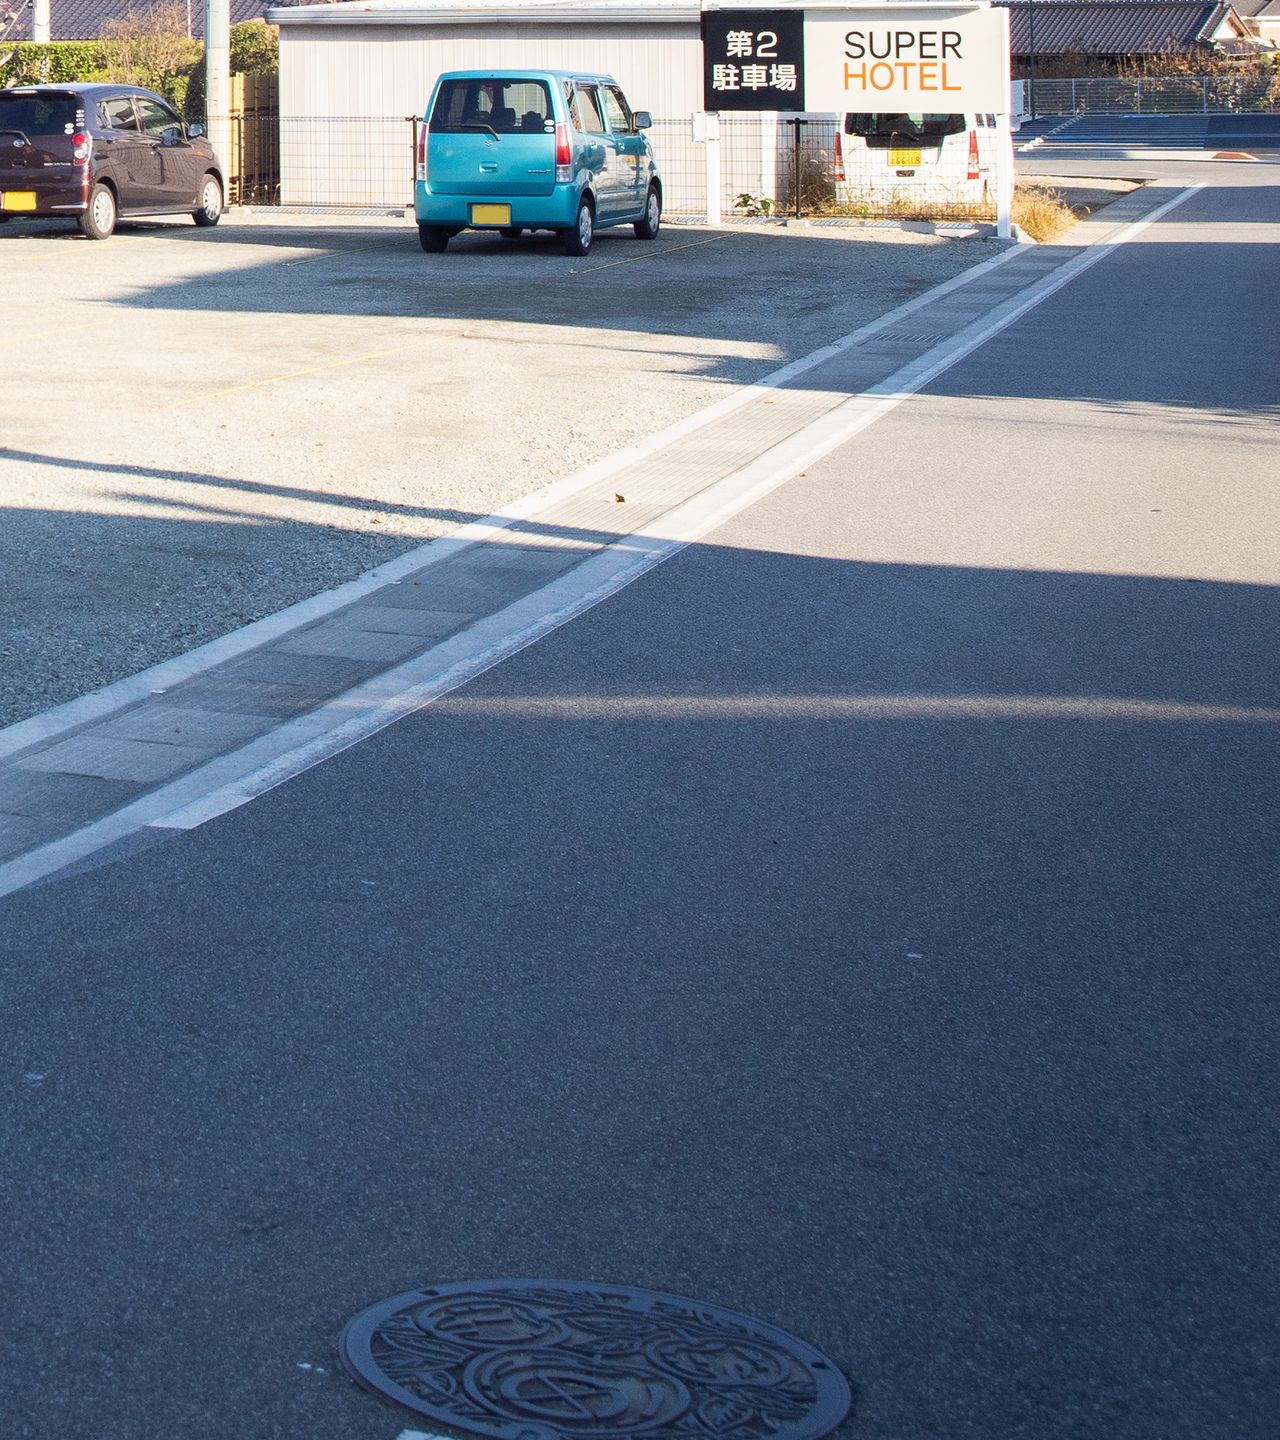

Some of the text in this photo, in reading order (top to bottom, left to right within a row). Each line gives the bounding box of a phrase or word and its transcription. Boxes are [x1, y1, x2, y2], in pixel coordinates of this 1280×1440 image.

[726, 31, 778, 58] 第2
[844, 31, 963, 59] SUPER
[712, 64, 797, 91] 駐車場
[844, 62, 962, 91] HOTEL
